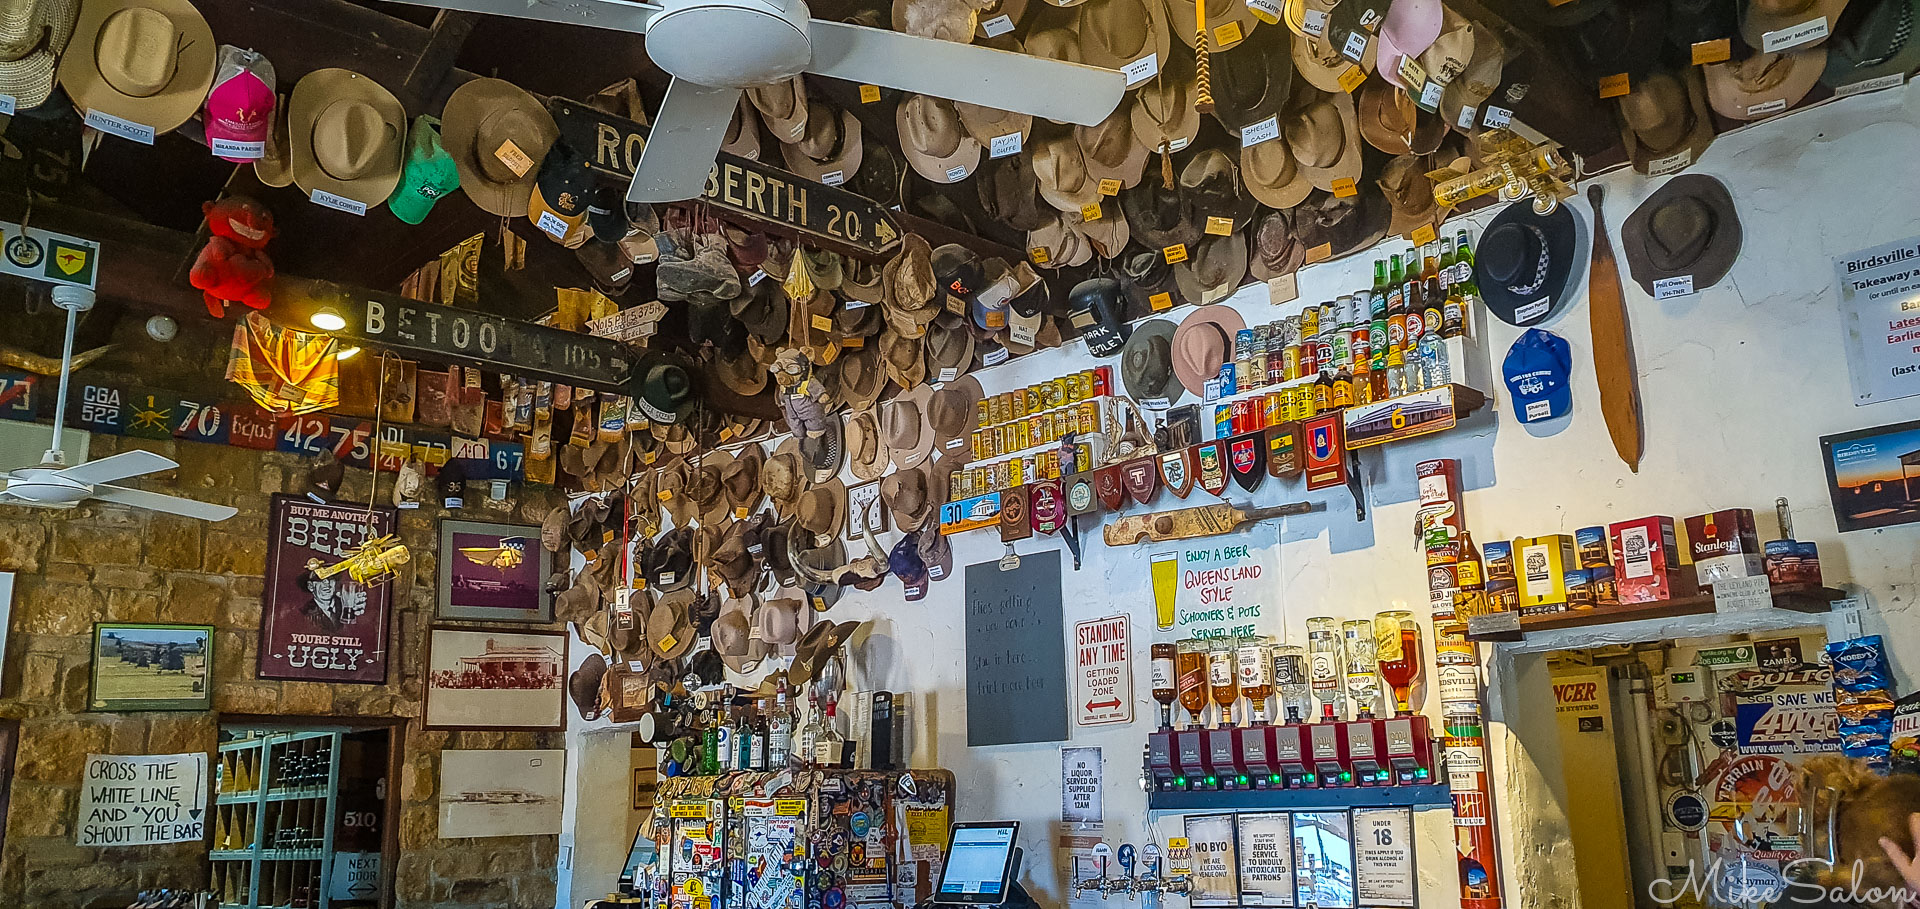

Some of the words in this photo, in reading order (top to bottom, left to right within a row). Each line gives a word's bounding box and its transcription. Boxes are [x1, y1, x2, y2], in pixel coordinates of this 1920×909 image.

[1795, 25, 1825, 39] McINTYRE
[89, 113, 122, 130] HUNTER
[123, 124, 151, 138] SCOTT
[1245, 119, 1275, 137] SHELLIE
[1251, 131, 1272, 144] CASH
[215, 143, 240, 152] MIRANDA
[1662, 155, 1680, 165] DON
[598, 123, 807, 226] ROBERTH
[827, 205, 861, 241] 20
[1847, 248, 1914, 272] Birdsville
[1853, 270, 1911, 291] Takeaway
[1881, 289, 1898, 298] until
[1891, 364, 1916, 377] (last
[84, 385, 120, 406] CGA
[82, 407, 118, 425] 522
[179, 400, 221, 437] 70
[1392, 407, 1405, 429] 6
[285, 417, 323, 453] 42
[330, 425, 371, 460] 75
[418, 441, 447, 468] 73
[496, 450, 524, 471] 67
[290, 506, 310, 516] BUY
[312, 508, 328, 519] ME
[946, 504, 962, 525] 30
[1695, 537, 1733, 554] Stanley
[1185, 550, 1210, 563] ENJOY
[1214, 548, 1222, 560] A
[1224, 544, 1251, 559] BEER
[1200, 586, 1234, 605] STYLE
[1178, 608, 1224, 626] SCHOONERS
[1238, 605, 1261, 619] POTS
[1079, 621, 1125, 646] STANDING
[1230, 624, 1256, 638] HERE
[331, 636, 362, 647] STILL
[287, 645, 364, 671] UGLY
[1079, 647, 1099, 667] ANY
[1101, 643, 1126, 664] TIME
[1762, 657, 1796, 667] ZAMBO
[1086, 666, 1119, 679] GETTING
[1087, 676, 1118, 688] LOADED
[1092, 686, 1114, 697] ZONE
[1777, 693, 1809, 706] SAVE
[89, 759, 136, 781] CROSS
[147, 761, 178, 780] THE
[1071, 769, 1093, 778] LIQUOR
[1066, 777, 1087, 785] SERVED
[1089, 777, 1098, 785] OR
[1717, 758, 1764, 802] TERRAIN
[89, 786, 135, 803] WHITE
[140, 786, 180, 803] LINE
[1068, 785, 1096, 793] SUPPLIED
[1073, 793, 1091, 801] AFTER
[1074, 801, 1090, 809] 12AM
[87, 807, 127, 823] AND
[343, 811, 377, 827] 510
[84, 826, 134, 844] SHOUT
[142, 825, 170, 841] THE
[173, 822, 203, 840] BAR
[1373, 829, 1393, 846] 18
[1195, 842, 1208, 853] NO
[1210, 841, 1227, 852] BYO
[1252, 850, 1278, 858] SERVICE
[1253, 843, 1277, 851] REFUSE
[1258, 858, 1283, 866] UNDULY
[1753, 850, 1784, 860] Quality
[349, 858, 377, 869] NEXT
[1246, 866, 1286, 874] INTOXICATED
[348, 869, 377, 881] DOOR
[1252, 874, 1281, 882] PATRONS
